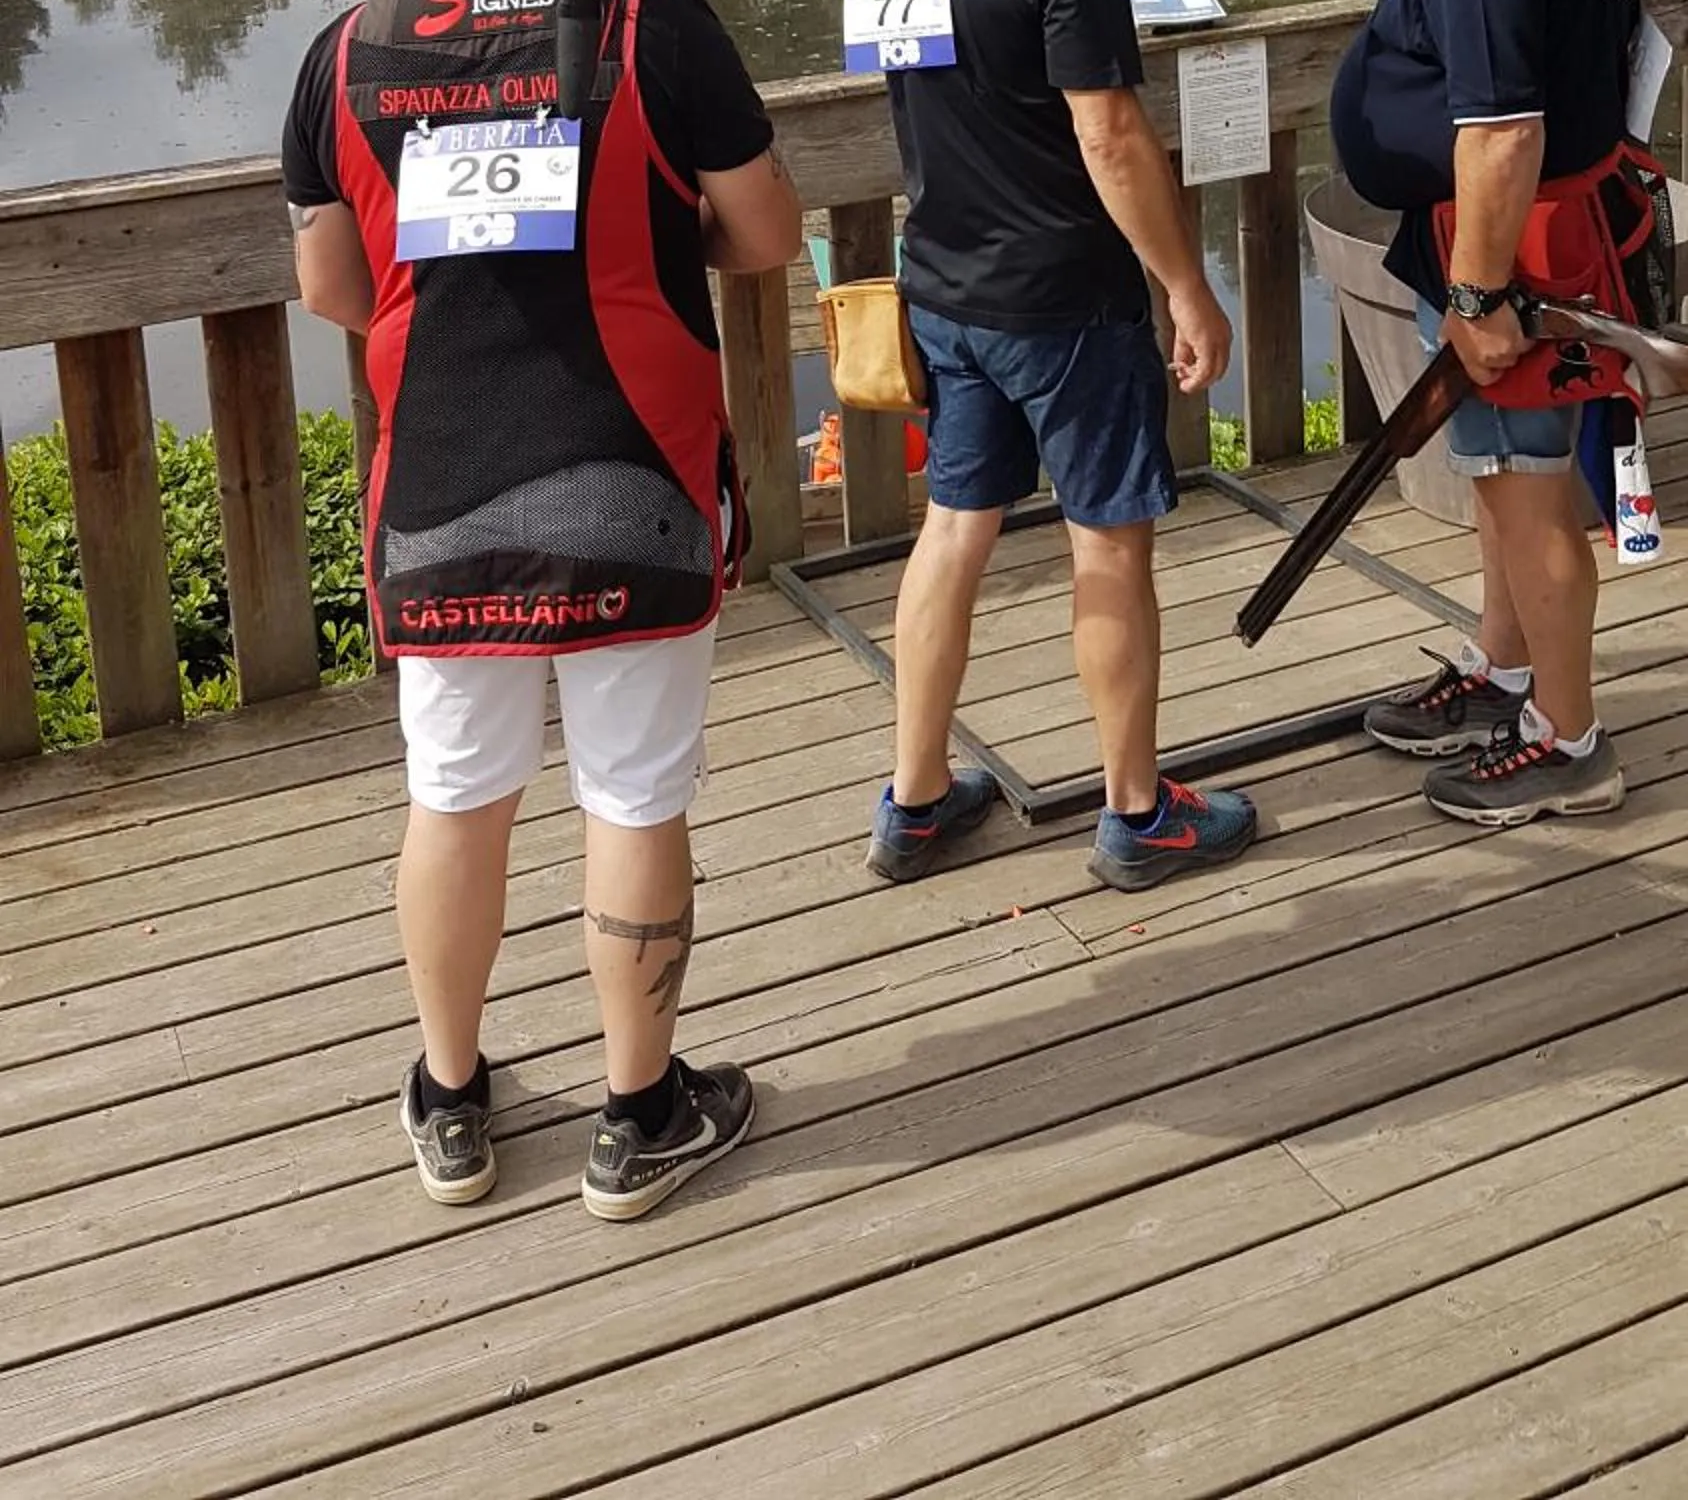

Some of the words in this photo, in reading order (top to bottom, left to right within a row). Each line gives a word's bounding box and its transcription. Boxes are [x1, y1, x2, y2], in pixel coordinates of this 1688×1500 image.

[879, 39, 920, 67] FOB
[379, 83, 492, 114] SPATAZZA
[502, 73, 558, 103] OLIVI
[451, 124, 565, 150] BERETTA
[447, 153, 521, 197] 26
[448, 212, 517, 250] FOB
[401, 594, 596, 629] CASTELLANI
